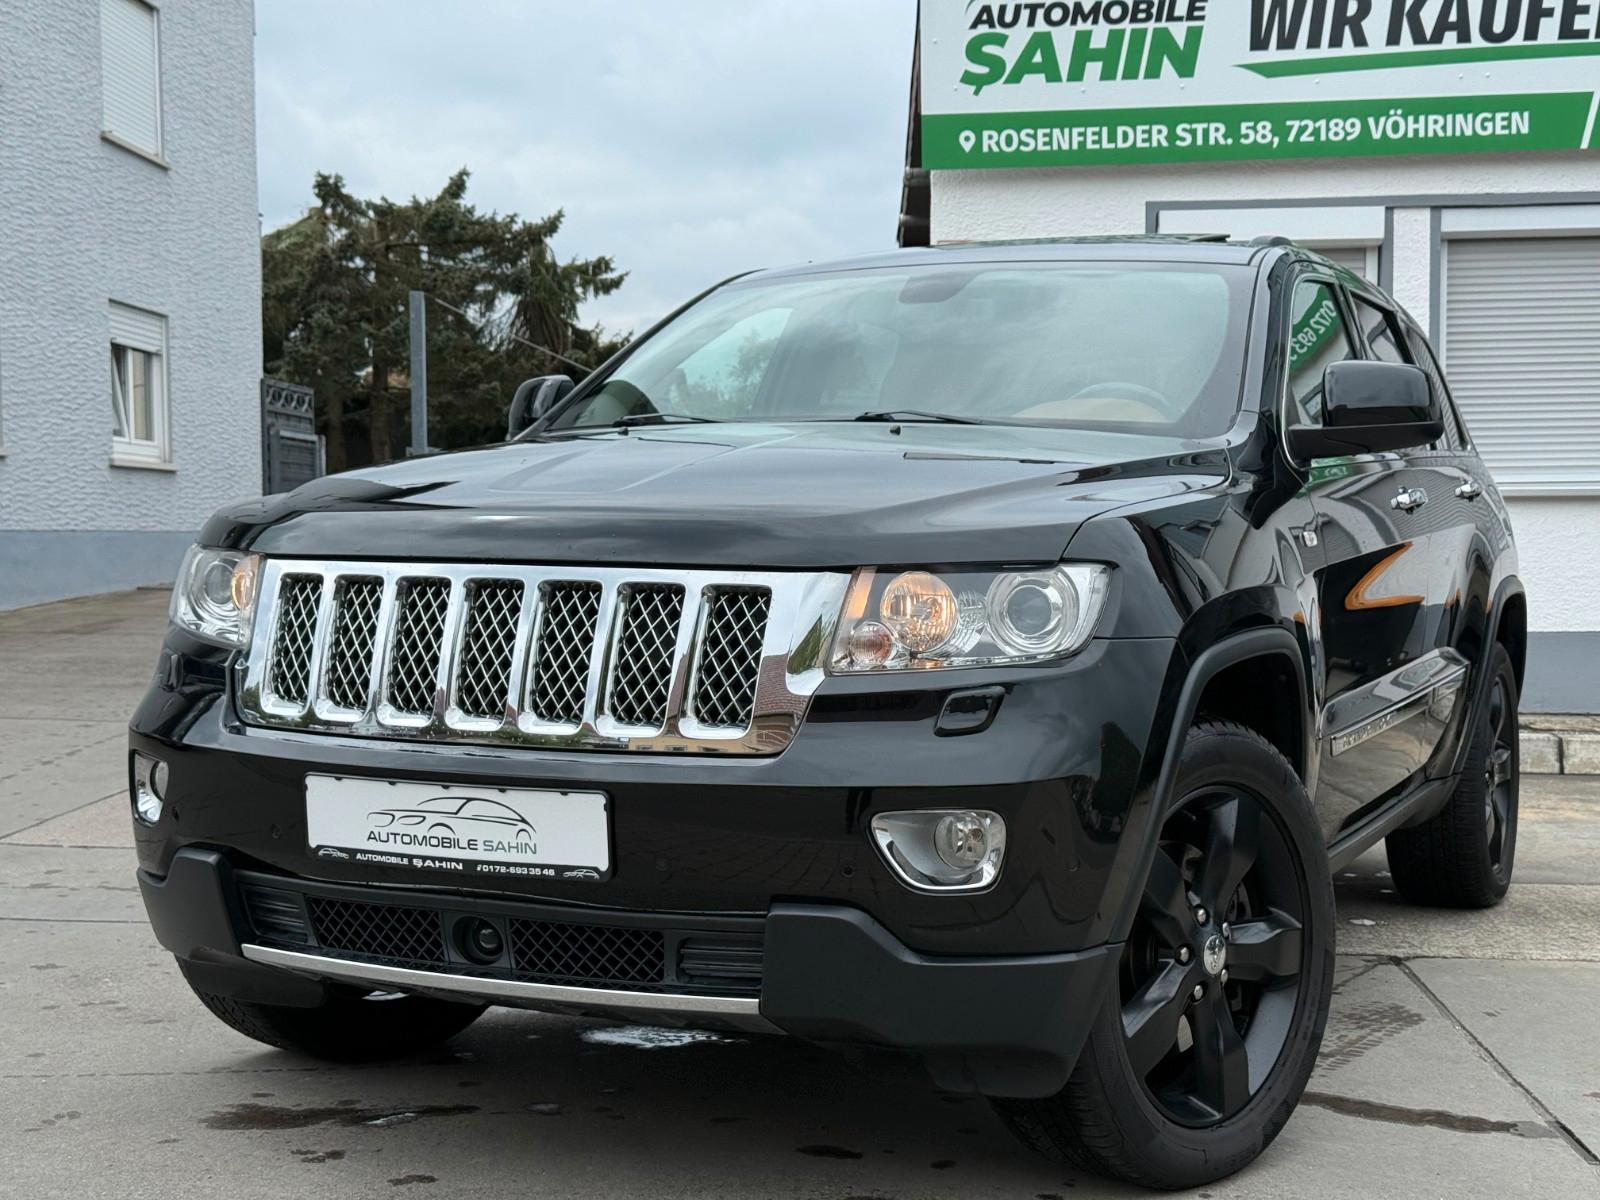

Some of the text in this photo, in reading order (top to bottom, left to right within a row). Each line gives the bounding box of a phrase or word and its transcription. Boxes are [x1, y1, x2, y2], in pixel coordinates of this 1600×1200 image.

[969, 0, 1208, 29] AUTOMOBILE
[1250, 0, 1600, 51] WIR KAUFE
[959, 25, 1204, 96] ŞAHIN
[982, 109, 1530, 153] ROSENFELDER STR. 58, 72189 VÖHRINGEN
[355, 852, 409, 865] AUTOMOBILE
[366, 831, 537, 854] AUTOMOBILE SAHIN
